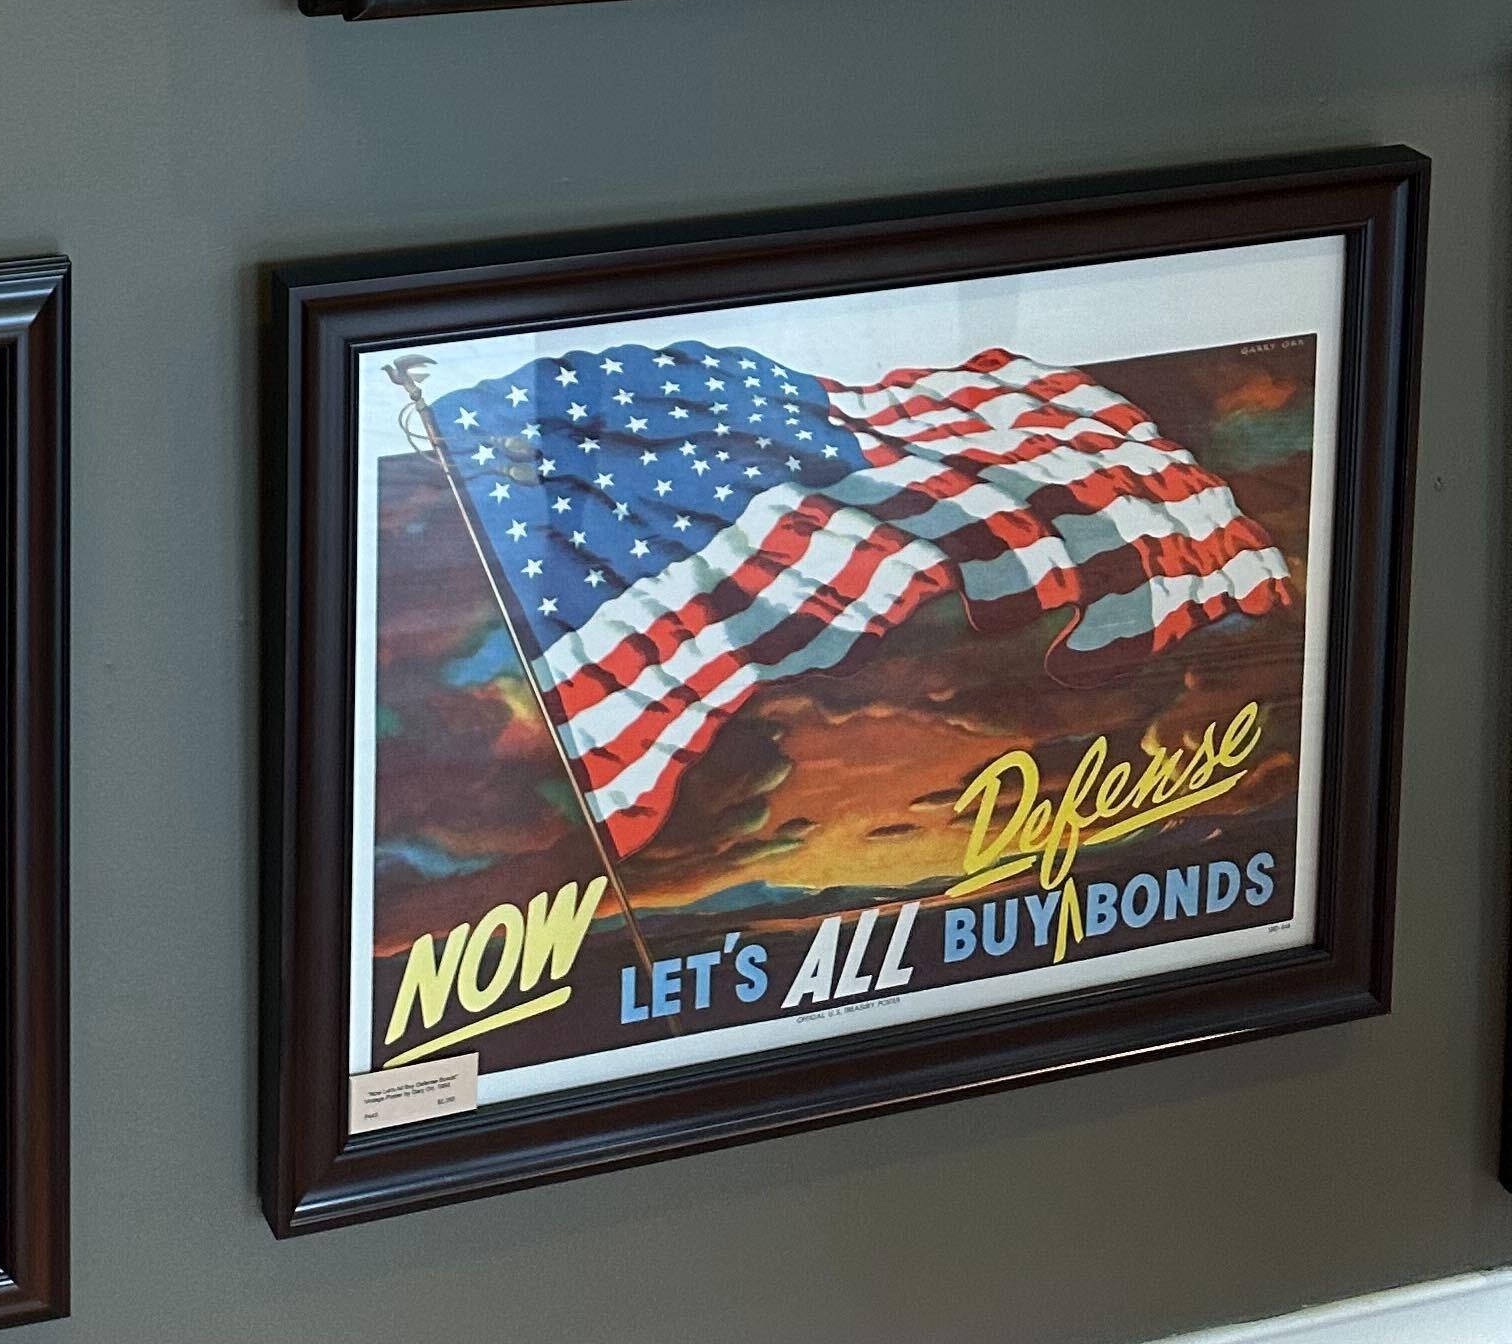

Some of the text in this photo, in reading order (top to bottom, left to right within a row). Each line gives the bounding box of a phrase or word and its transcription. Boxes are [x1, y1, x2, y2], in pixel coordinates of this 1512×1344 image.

[949, 703, 1261, 896] Defense
[384, 874, 1061, 1045] NOW LET'S ALL BUY
[1093, 851, 1276, 938] BONDS
